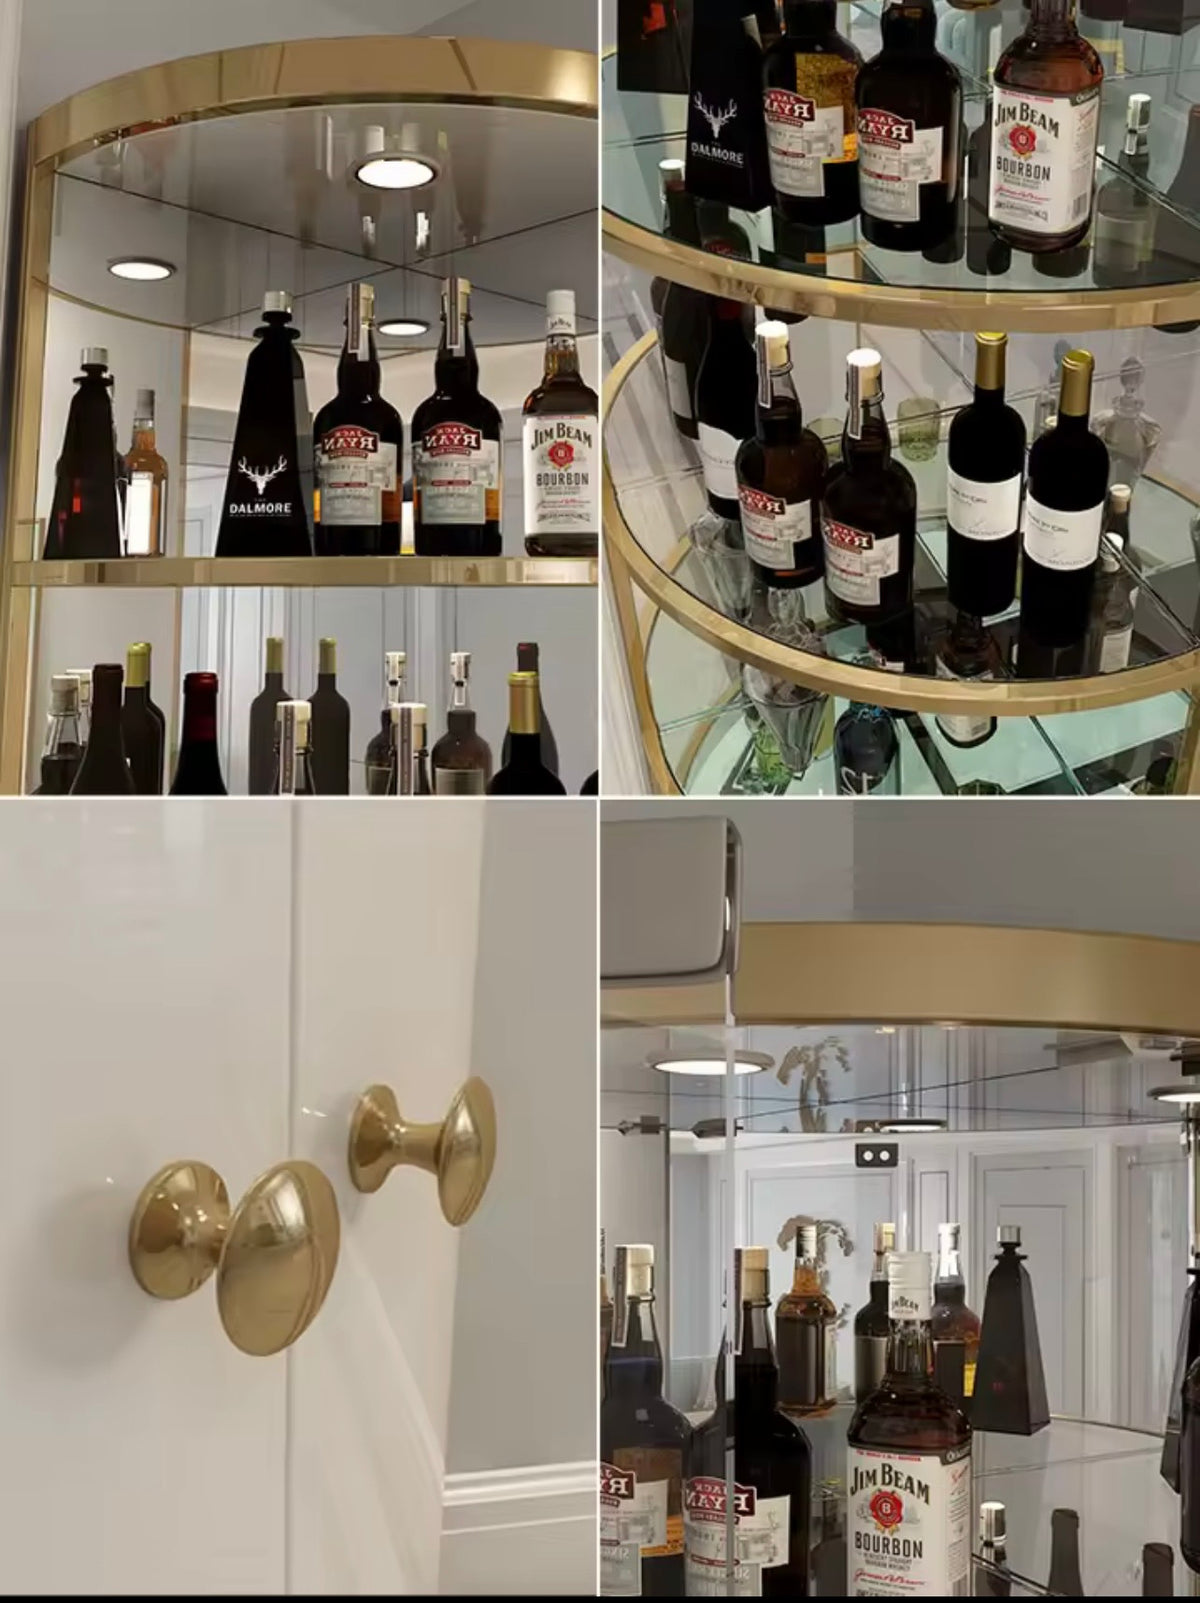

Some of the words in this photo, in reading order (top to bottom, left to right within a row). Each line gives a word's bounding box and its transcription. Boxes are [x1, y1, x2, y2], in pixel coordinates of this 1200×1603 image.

[995, 103, 1017, 127] JIM
[1020, 102, 1060, 139] BEAM
[690, 142, 744, 164] DALMORE
[996, 155, 1051, 181] BOURBON
[531, 427, 554, 450] JIM
[556, 422, 592, 448] BEAM
[536, 473, 589, 487] BOURBON
[229, 502, 292, 514] DALMORE
[850, 1466, 878, 1496] JIM
[881, 1462, 930, 1506] BEAM
[854, 1531, 923, 1559] BOURBON
